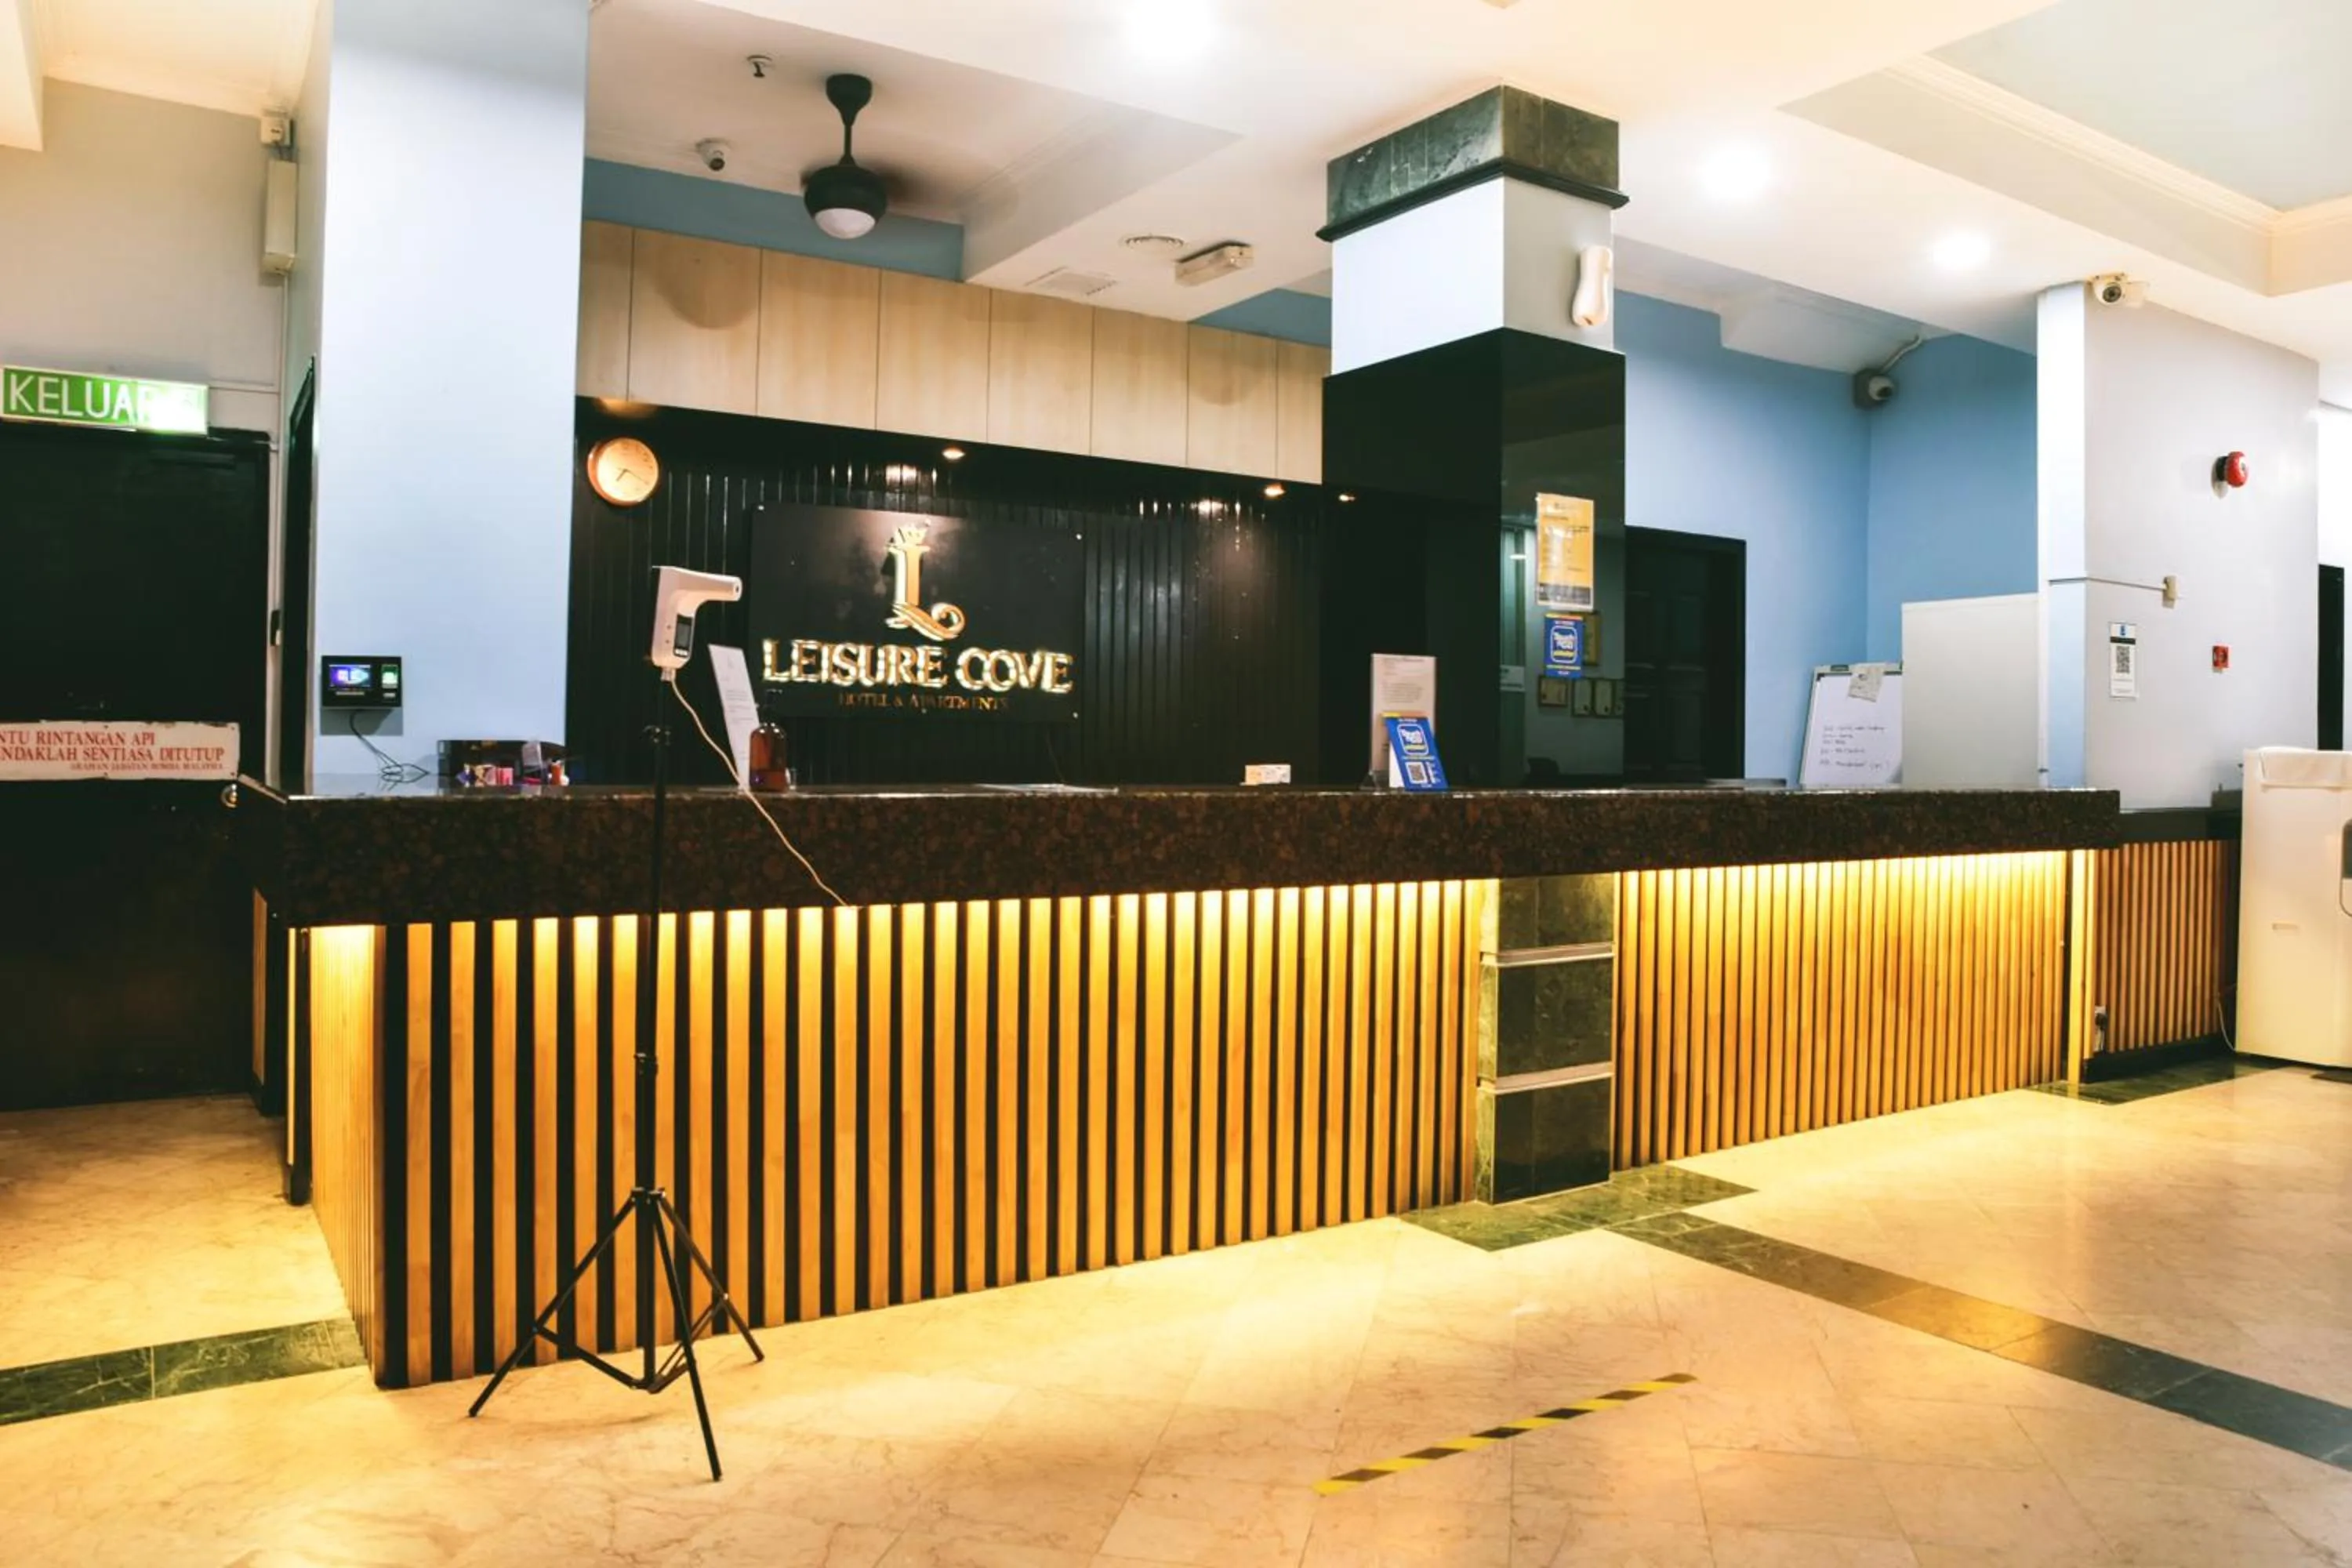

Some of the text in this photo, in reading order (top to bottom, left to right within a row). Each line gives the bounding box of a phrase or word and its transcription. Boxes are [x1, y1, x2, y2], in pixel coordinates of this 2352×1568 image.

[762, 638, 1074, 694] LEISURE COVE
[36, 731, 127, 746] RINTANGAN
[132, 731, 156, 746] API
[82, 747, 154, 761] SENTIASA
[159, 747, 225, 762] DITUTUP
